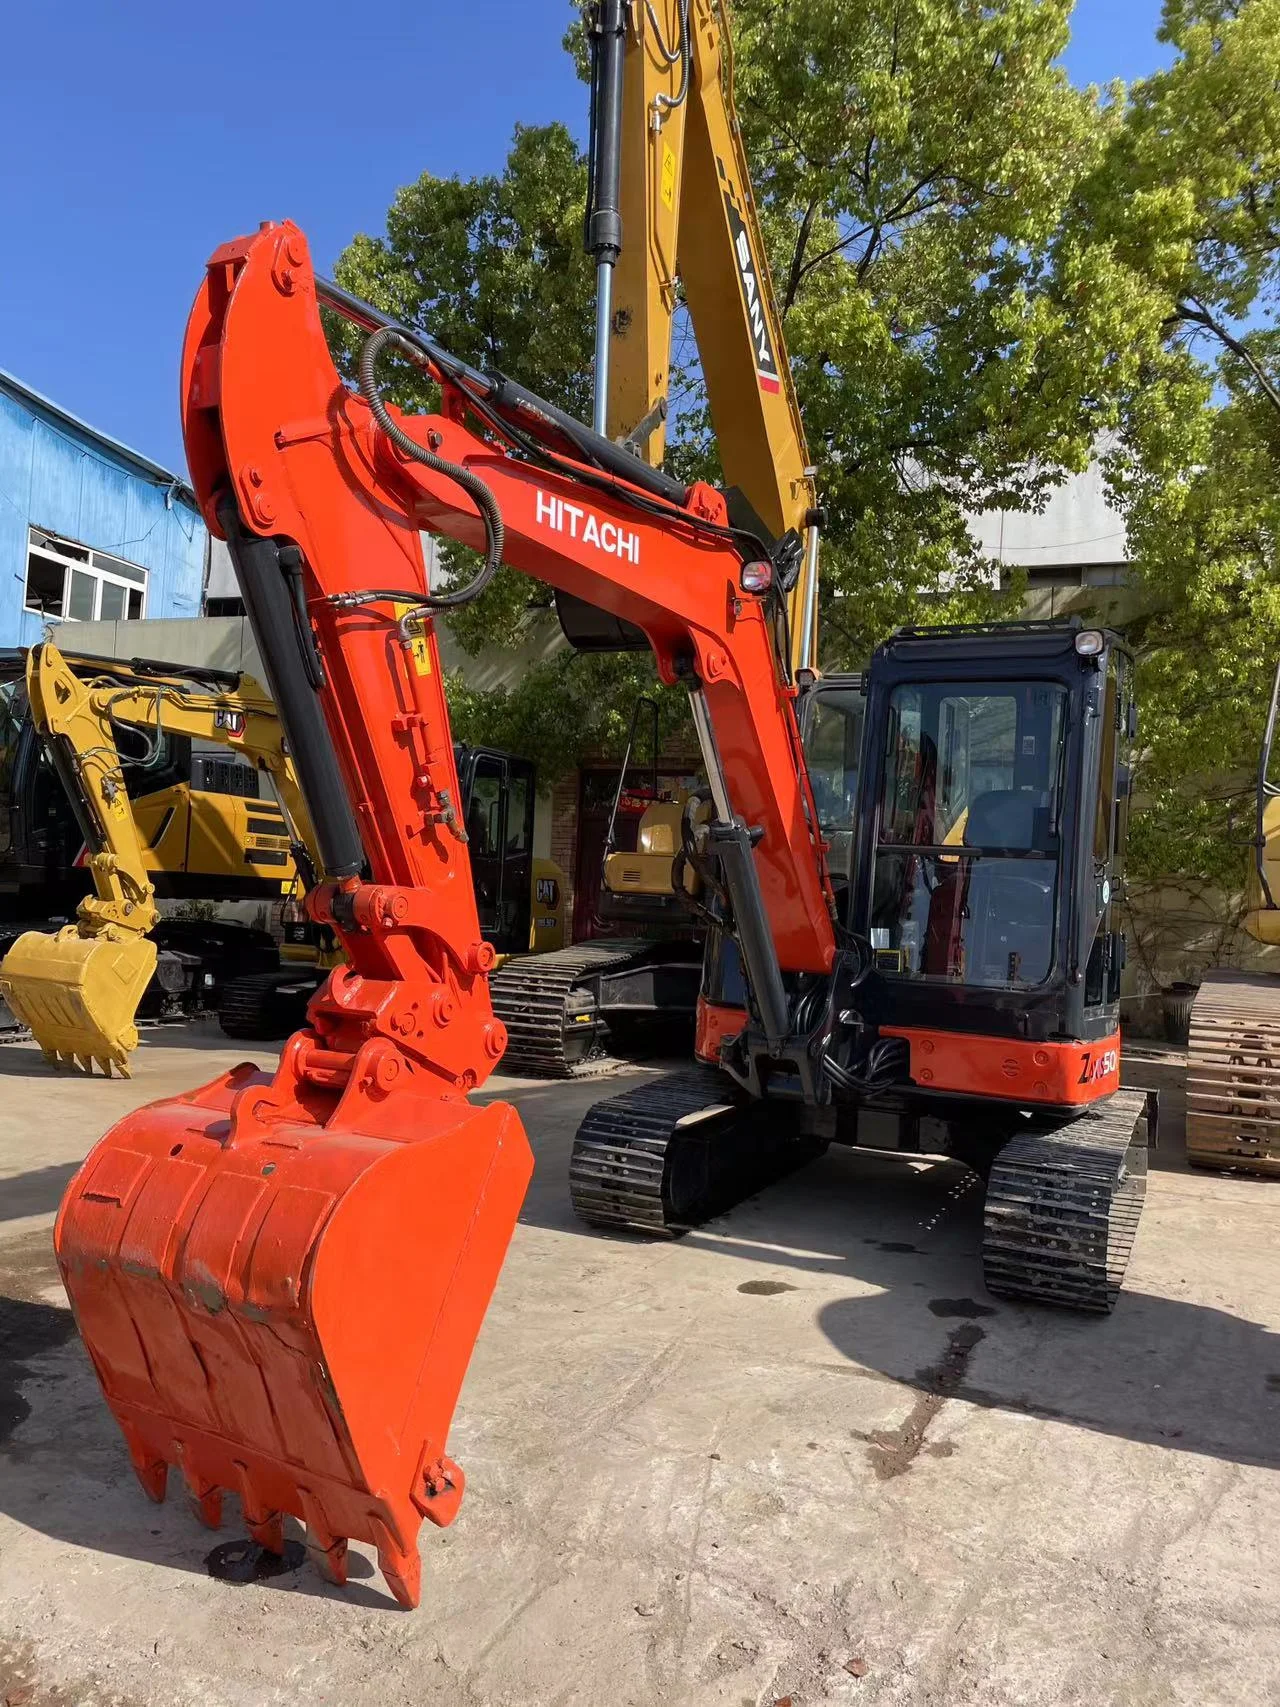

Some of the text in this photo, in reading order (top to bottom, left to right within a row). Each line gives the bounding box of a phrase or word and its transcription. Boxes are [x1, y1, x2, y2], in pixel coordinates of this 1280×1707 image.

[736, 230, 770, 362] SANY
[536, 489, 640, 565] HITACHI
[214, 710, 237, 731] CAT
[536, 879, 555, 902] CAT
